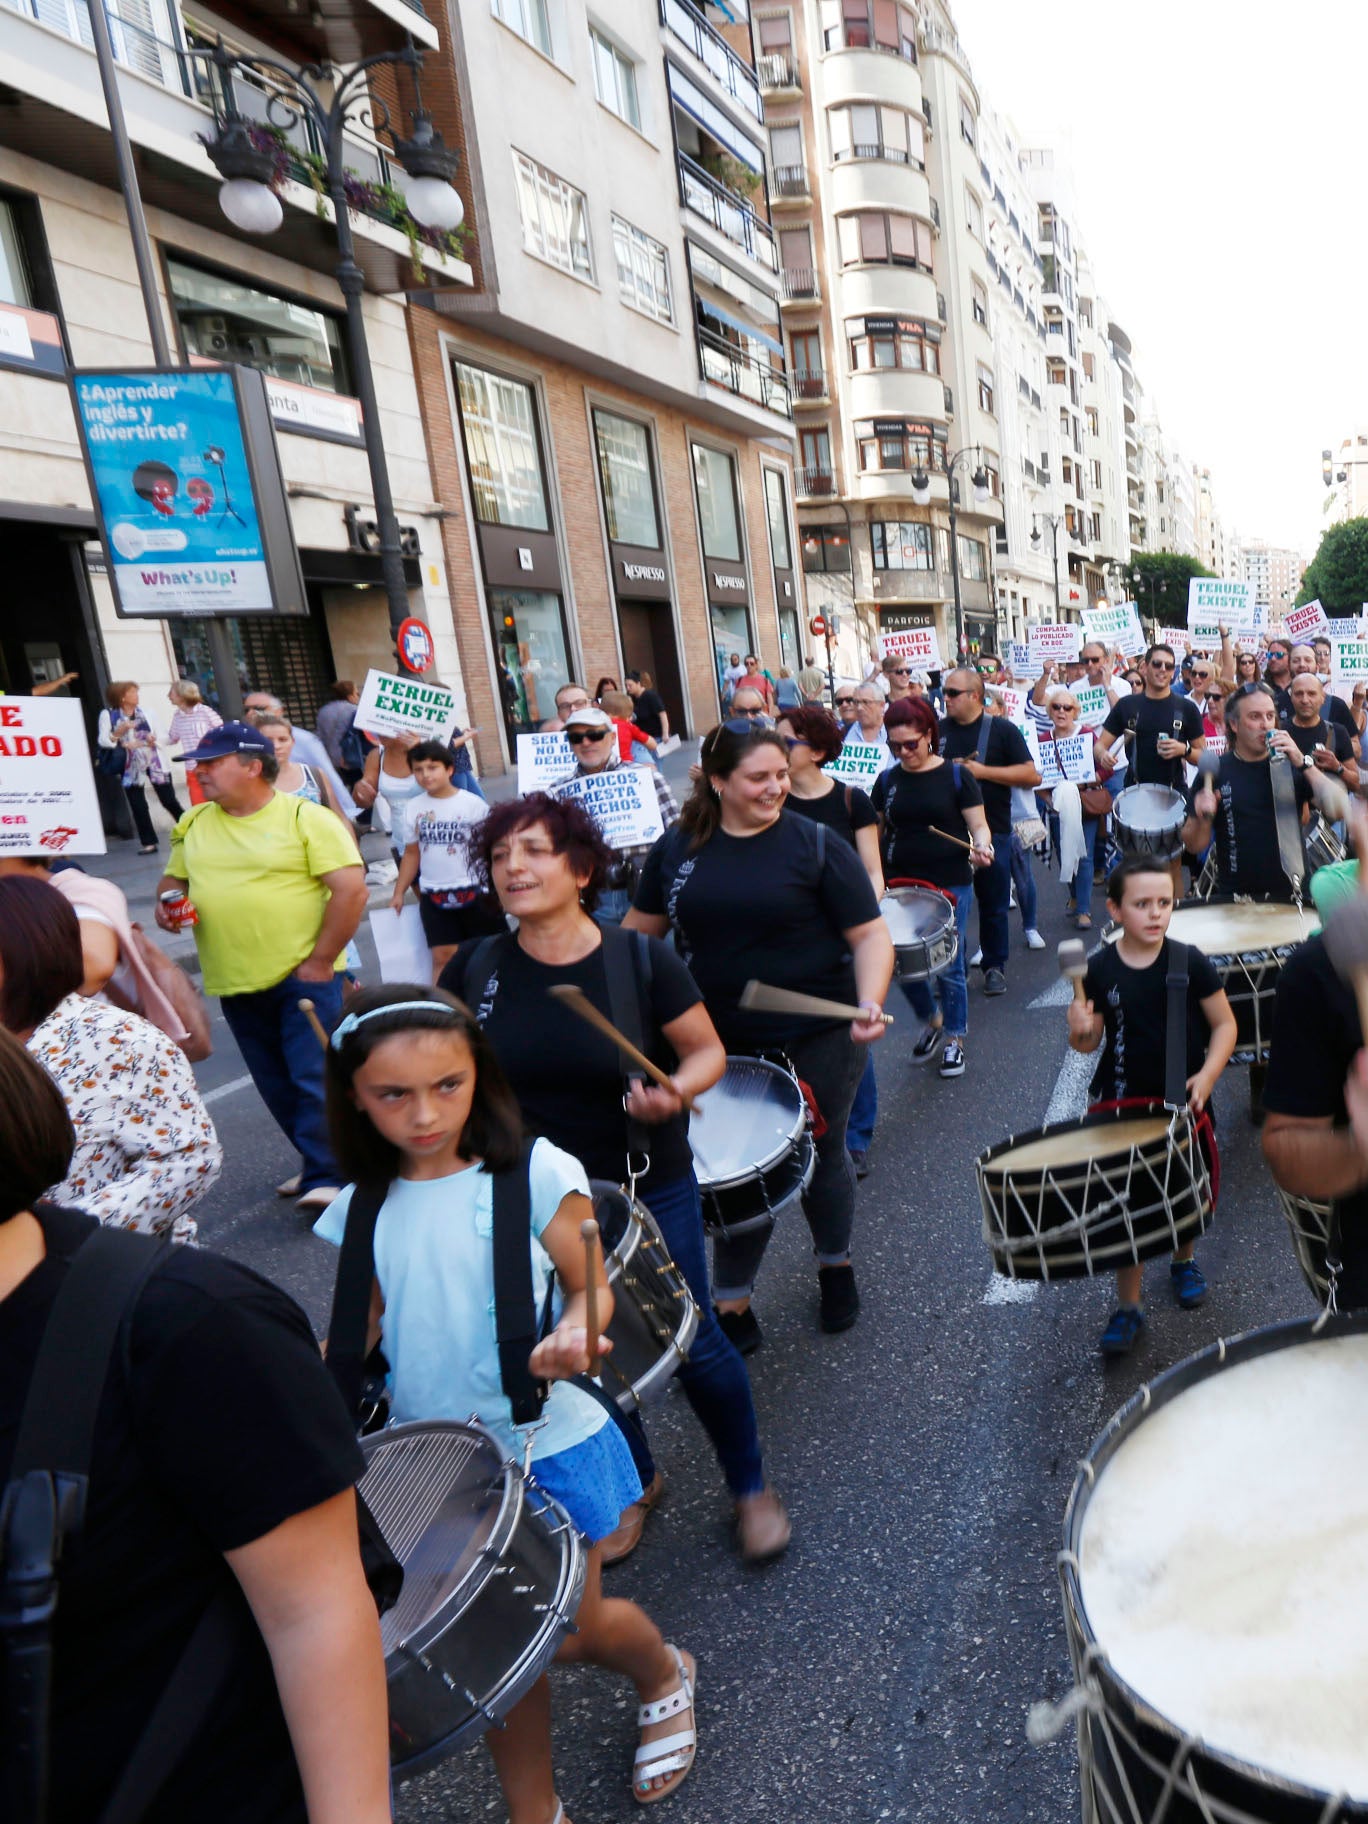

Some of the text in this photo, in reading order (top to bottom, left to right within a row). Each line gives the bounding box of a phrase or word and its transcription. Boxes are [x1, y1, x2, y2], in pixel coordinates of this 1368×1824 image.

[81, 383, 178, 404] ¿Aprender
[85, 403, 153, 424] inglés y
[89, 423, 188, 441] divertirte?
[141, 569, 238, 586] What's Up!
[621, 561, 665, 582] NESPRESSO
[713, 572, 745, 591] NESPRESSO
[1196, 582, 1249, 595] TERUEL
[1197, 595, 1247, 608] EXISTE
[887, 616, 930, 625] PARFOIS
[1087, 608, 1129, 622] TERUEL
[1285, 605, 1318, 625] TERUEL
[1092, 619, 1130, 632] EXISTE
[1290, 613, 1321, 634] EXISTE
[882, 632, 931, 647] TERUEL
[886, 644, 931, 657] EXISTE
[378, 677, 454, 709] TERUEL
[375, 694, 449, 724] EXISTE
[531, 735, 558, 745] SER
[1056, 736, 1085, 747] POCOS
[536, 745, 555, 755] NO
[558, 772, 639, 798] SER POCOS
[583, 786, 636, 803] RESTA
[421, 821, 458, 831] SUPER
[419, 830, 466, 841] MARIO
